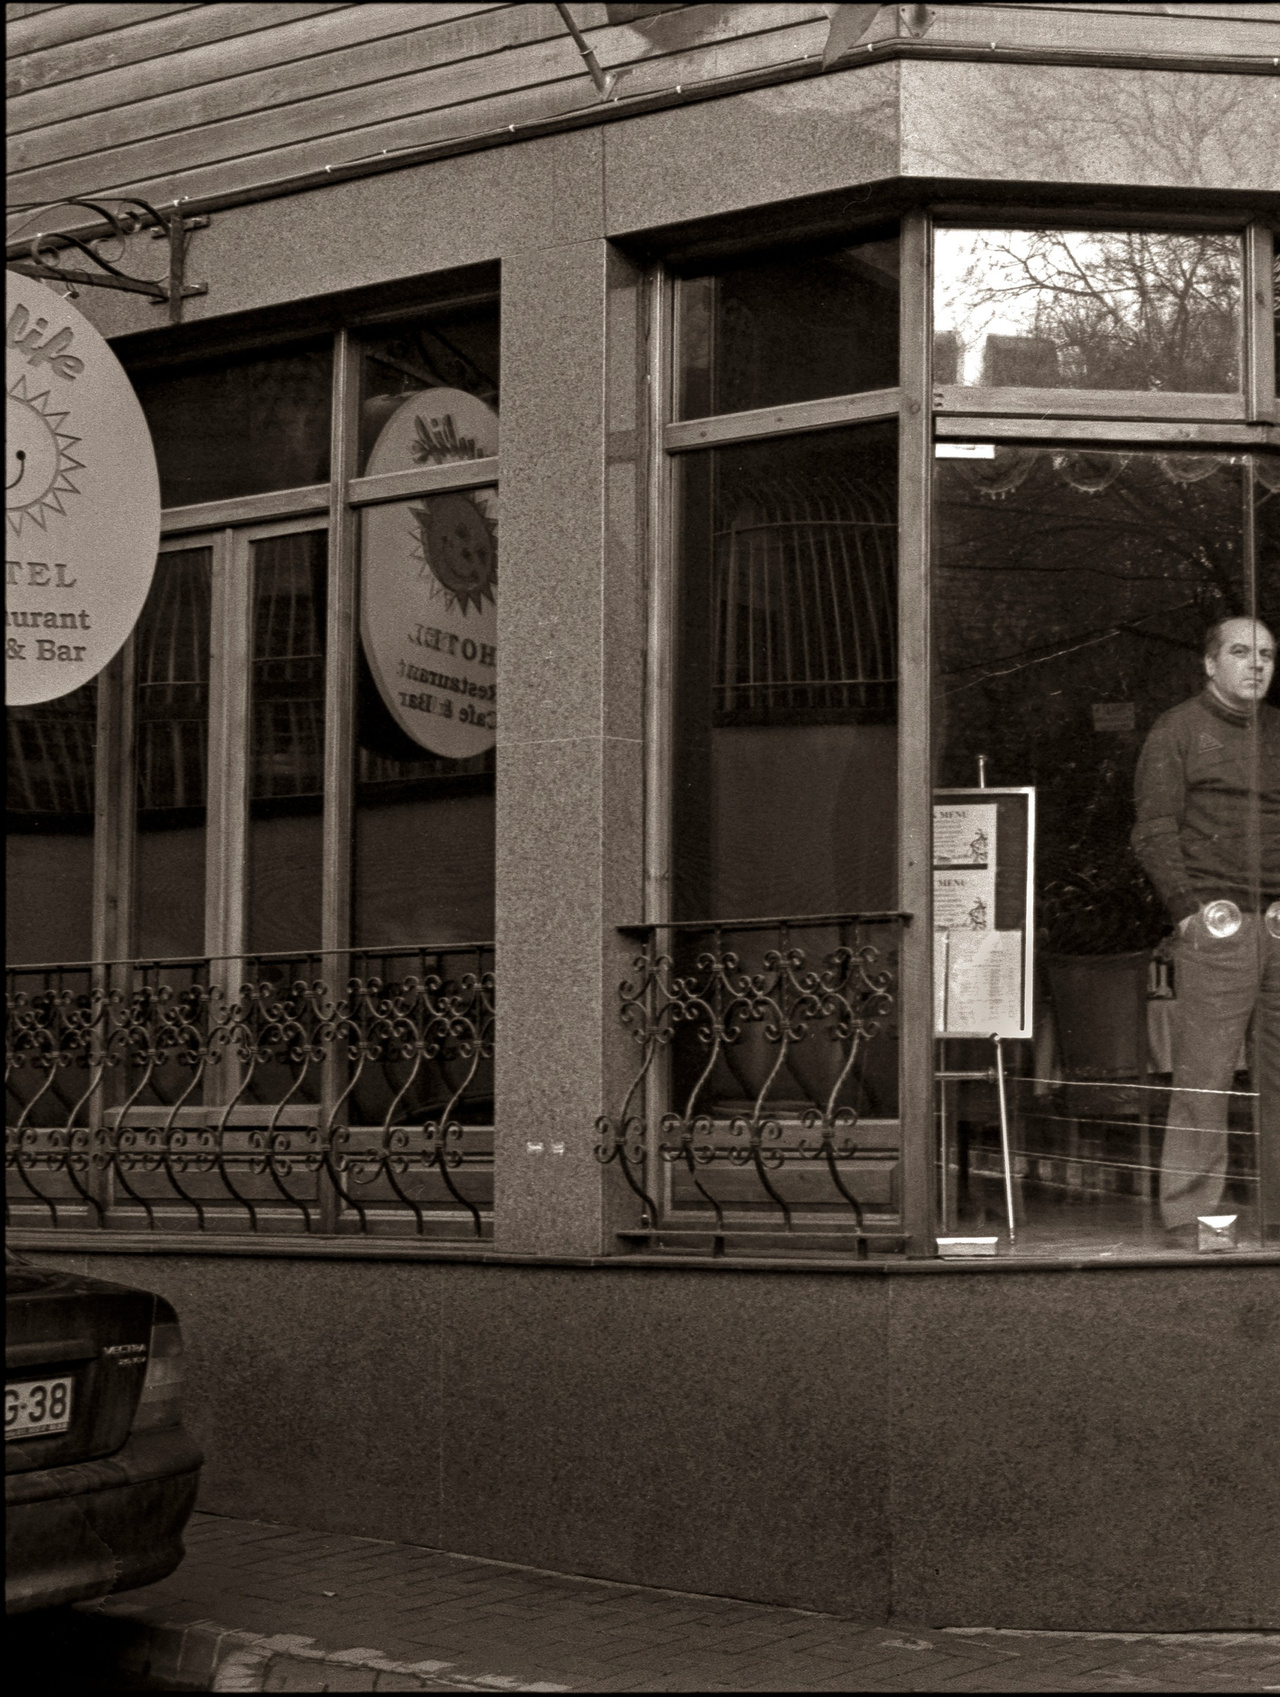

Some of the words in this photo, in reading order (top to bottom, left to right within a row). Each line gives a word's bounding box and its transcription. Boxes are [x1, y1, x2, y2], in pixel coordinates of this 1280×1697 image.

[6, 609, 91, 630] urant
[35, 639, 87, 661] Bar
[939, 810, 967, 819] MENU
[937, 879, 966, 887] MENU
